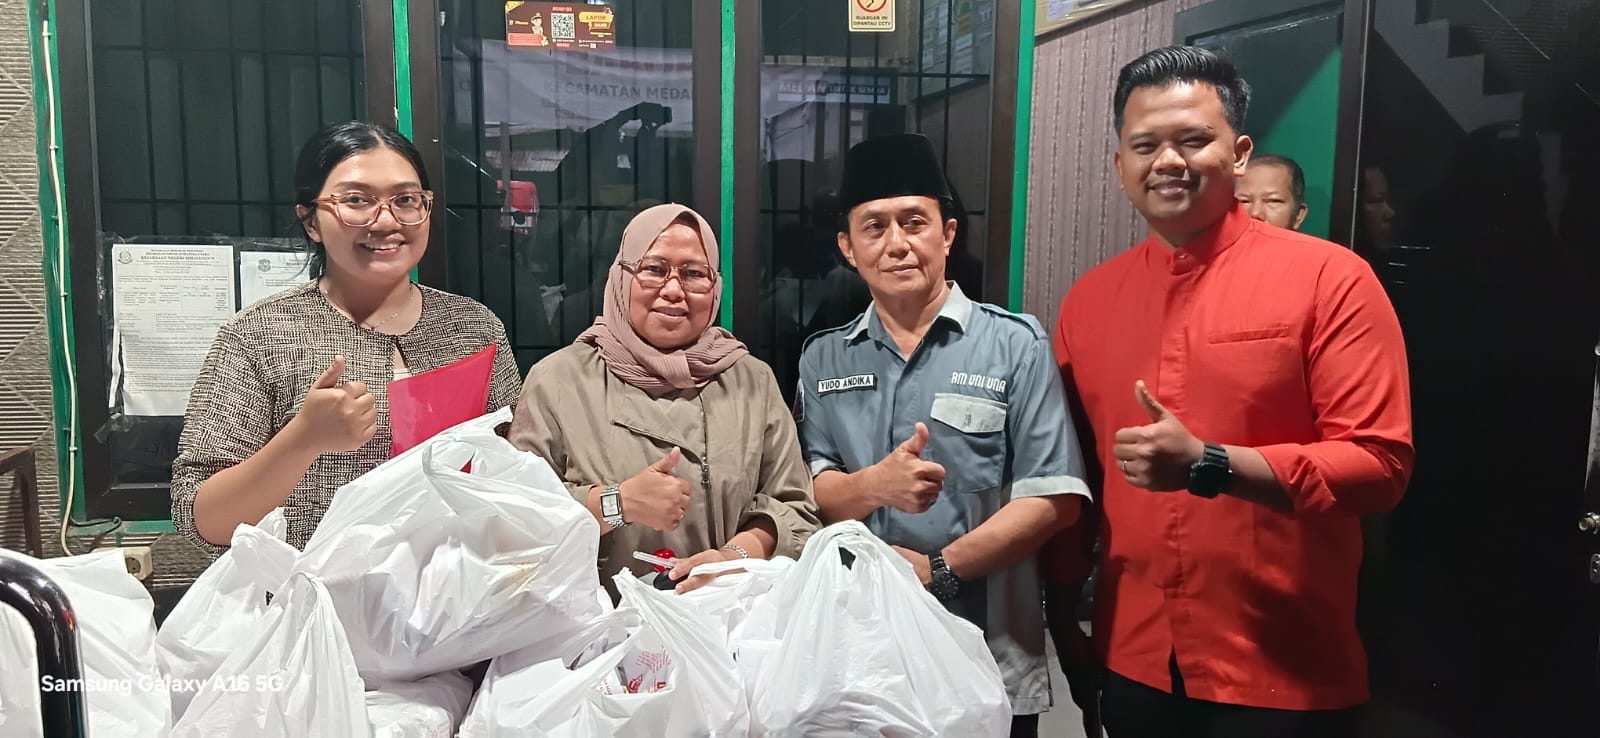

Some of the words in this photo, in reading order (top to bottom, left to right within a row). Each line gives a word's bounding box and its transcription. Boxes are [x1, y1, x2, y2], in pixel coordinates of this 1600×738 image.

[544, 80, 641, 99] KECAMATAN
[820, 379, 841, 390] YUDO
[843, 375, 871, 388] ANDIKA
[968, 374, 986, 388] UNI
[986, 377, 1007, 393] UNA
